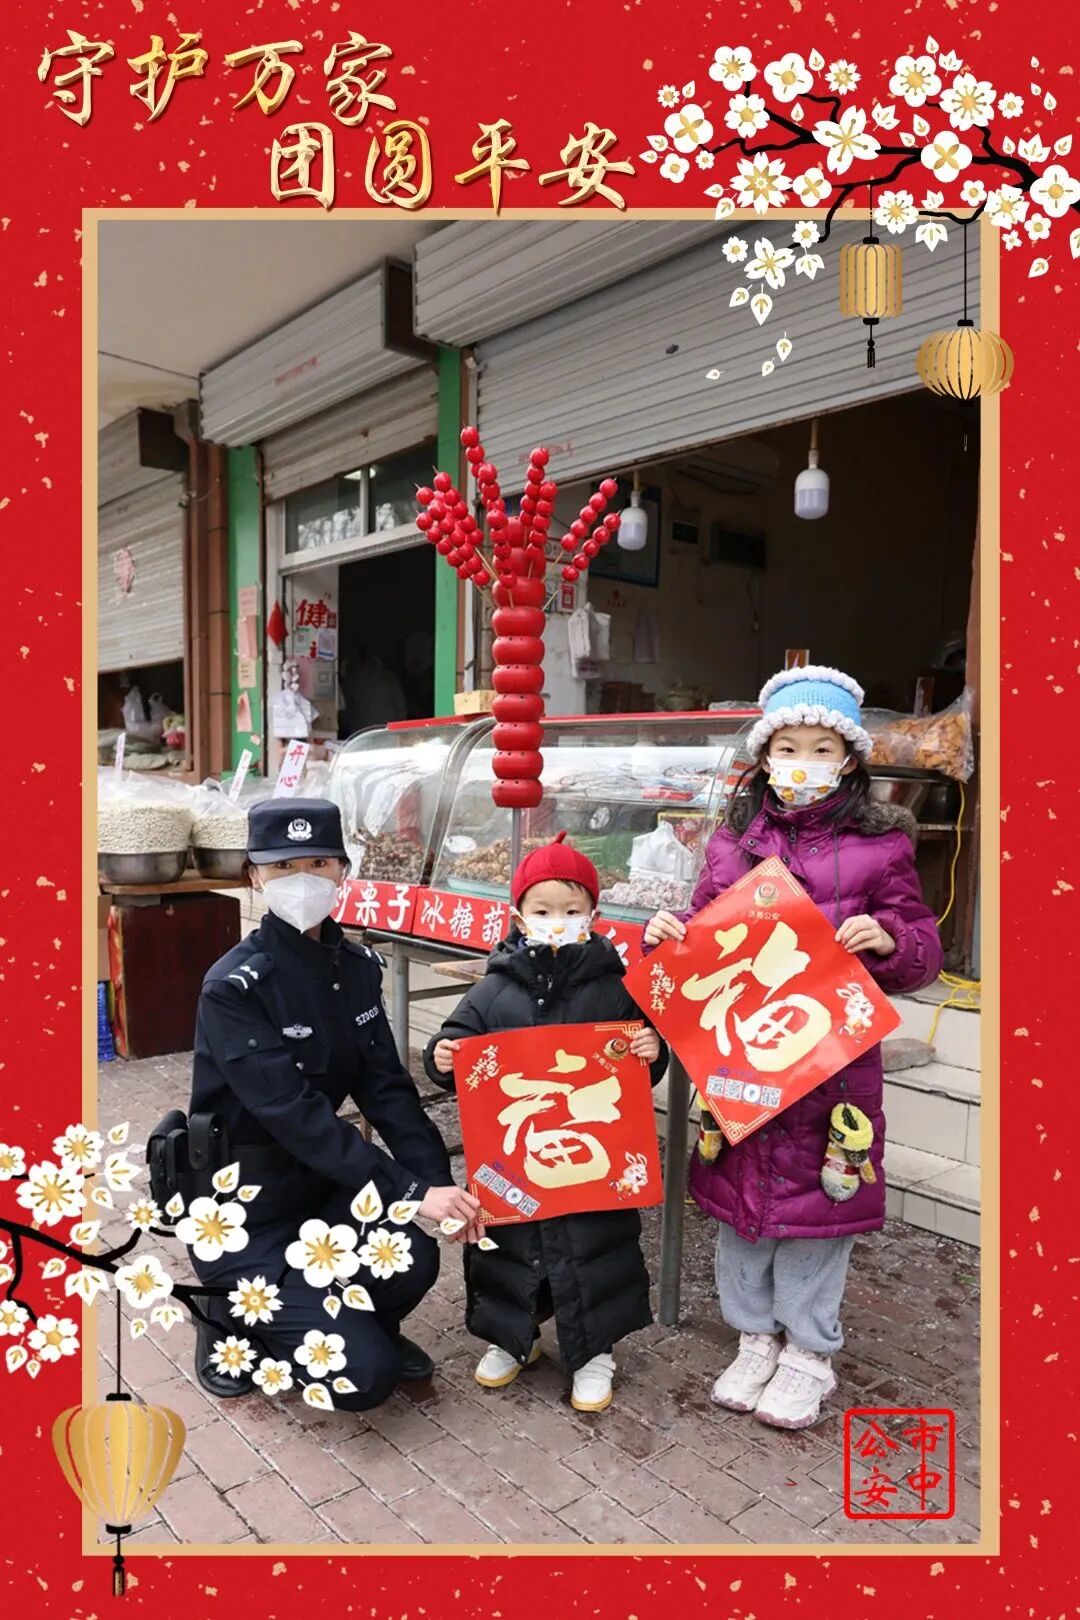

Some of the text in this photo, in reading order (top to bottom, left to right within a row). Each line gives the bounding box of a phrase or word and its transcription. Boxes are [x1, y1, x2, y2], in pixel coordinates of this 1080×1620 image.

[280, 744, 304, 800] 开心
[420, 894, 506, 946] 冰糖葫
[680, 921, 832, 1073] 福
[496, 1048, 622, 1190] 福
